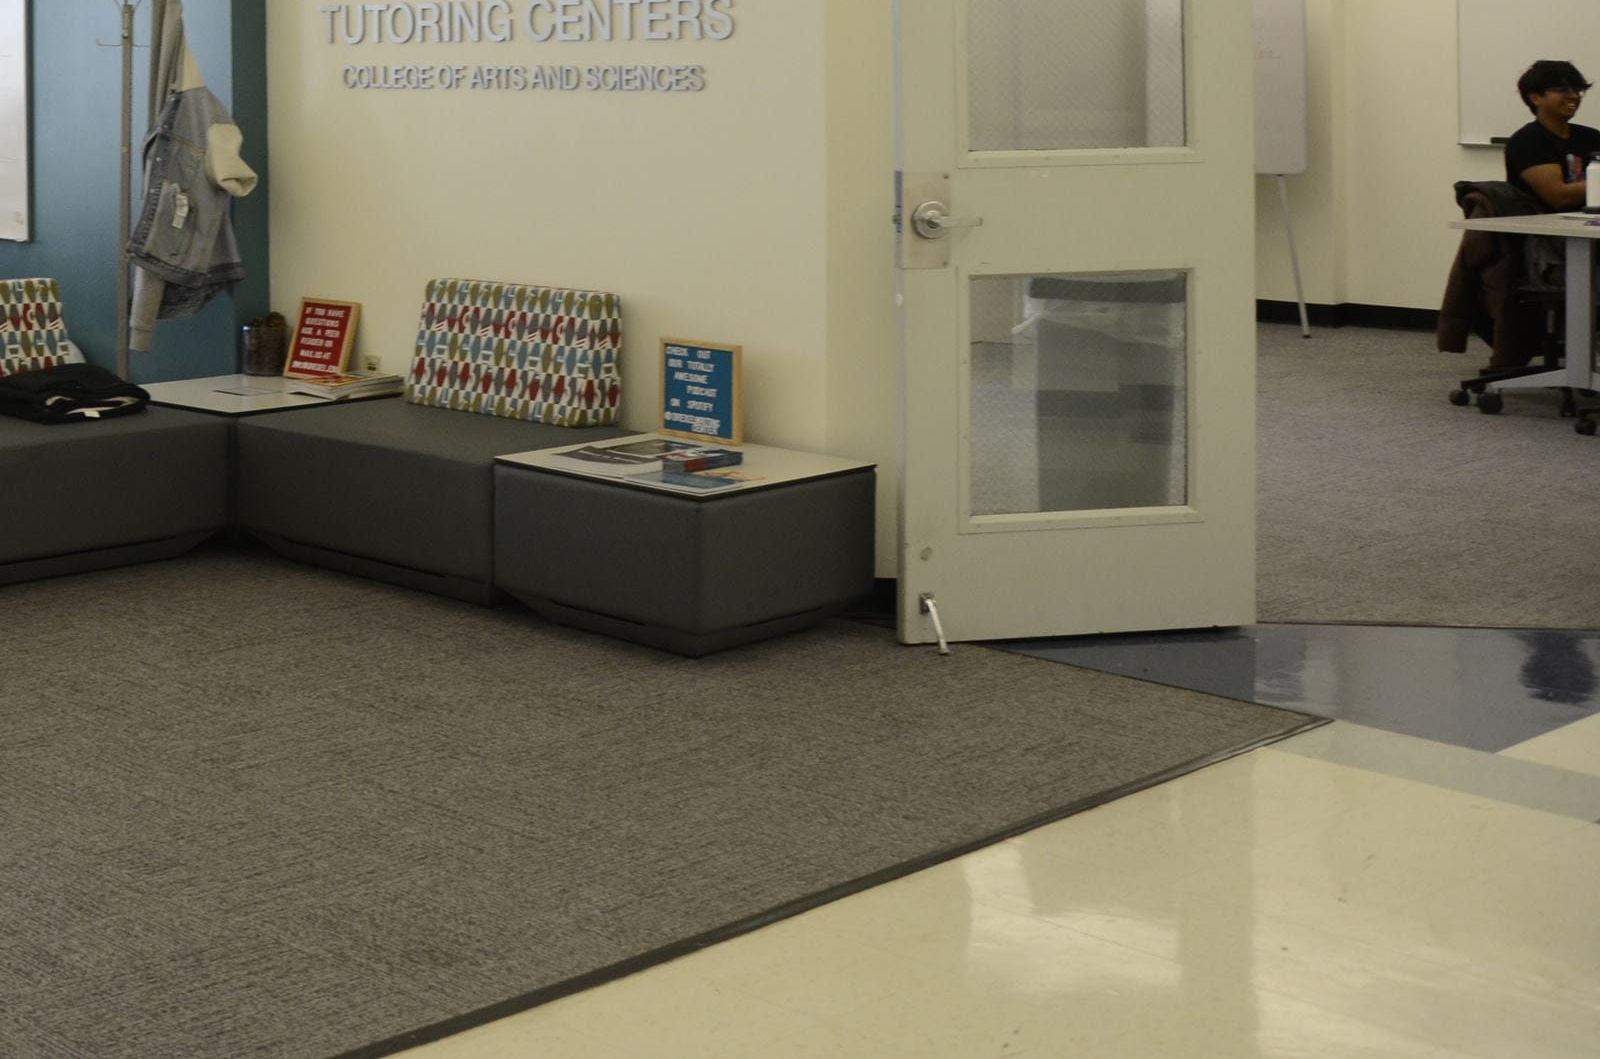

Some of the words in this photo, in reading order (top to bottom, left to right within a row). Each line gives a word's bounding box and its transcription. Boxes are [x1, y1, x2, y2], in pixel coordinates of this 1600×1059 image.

[342, 63, 434, 90] COLLEGE
[438, 65, 468, 90] OF
[470, 64, 526, 91] ARTS
[530, 64, 581, 91] AND
[585, 64, 706, 92] SCIENCES
[305, 306, 312, 314] IF
[314, 307, 325, 315] YOU
[327, 309, 345, 317] HAVE
[305, 317, 339, 327] QUESTIONS
[665, 346, 688, 356] CHECK
[696, 350, 711, 358] OUT
[667, 358, 682, 367] OUR
[686, 360, 714, 372] TOTALLY
[673, 371, 707, 383] AWESOME
[687, 385, 716, 397] PODCAST
[670, 397, 680, 406] ON
[686, 400, 713, 411] SPOTIFY
